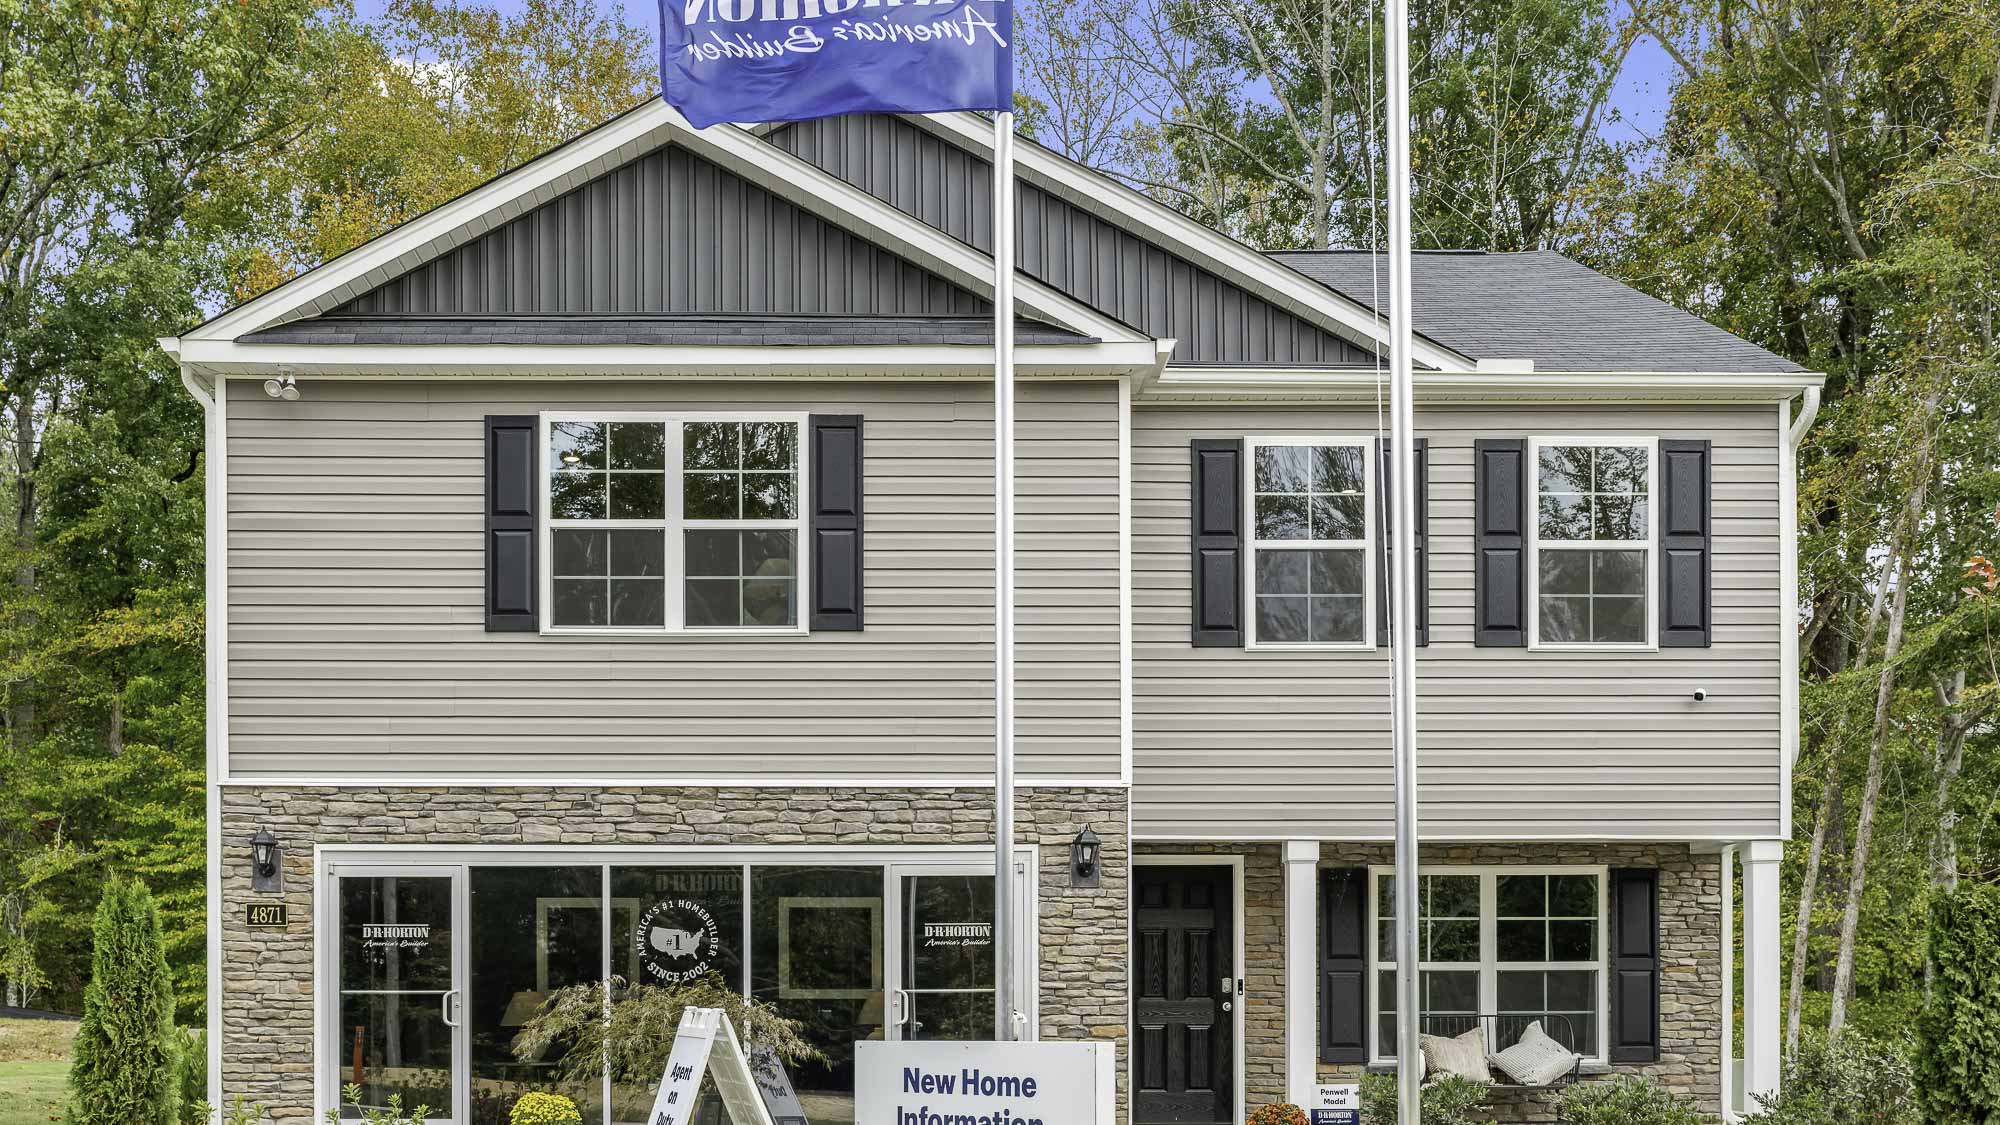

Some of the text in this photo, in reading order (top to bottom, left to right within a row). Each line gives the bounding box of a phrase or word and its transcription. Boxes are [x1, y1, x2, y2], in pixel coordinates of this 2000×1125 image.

[250, 906, 282, 924] 4871
[636, 905, 660, 957] AMERICA'S
[678, 899, 719, 957] HOMEBUILDER
[666, 934, 683, 951] #1
[647, 961, 709, 982] SINCE 2002
[670, 1062, 693, 1082] Agent
[903, 1067, 1037, 1098] New Home
[1320, 1088, 1349, 1096] Penwell
[667, 1090, 679, 1105] on
